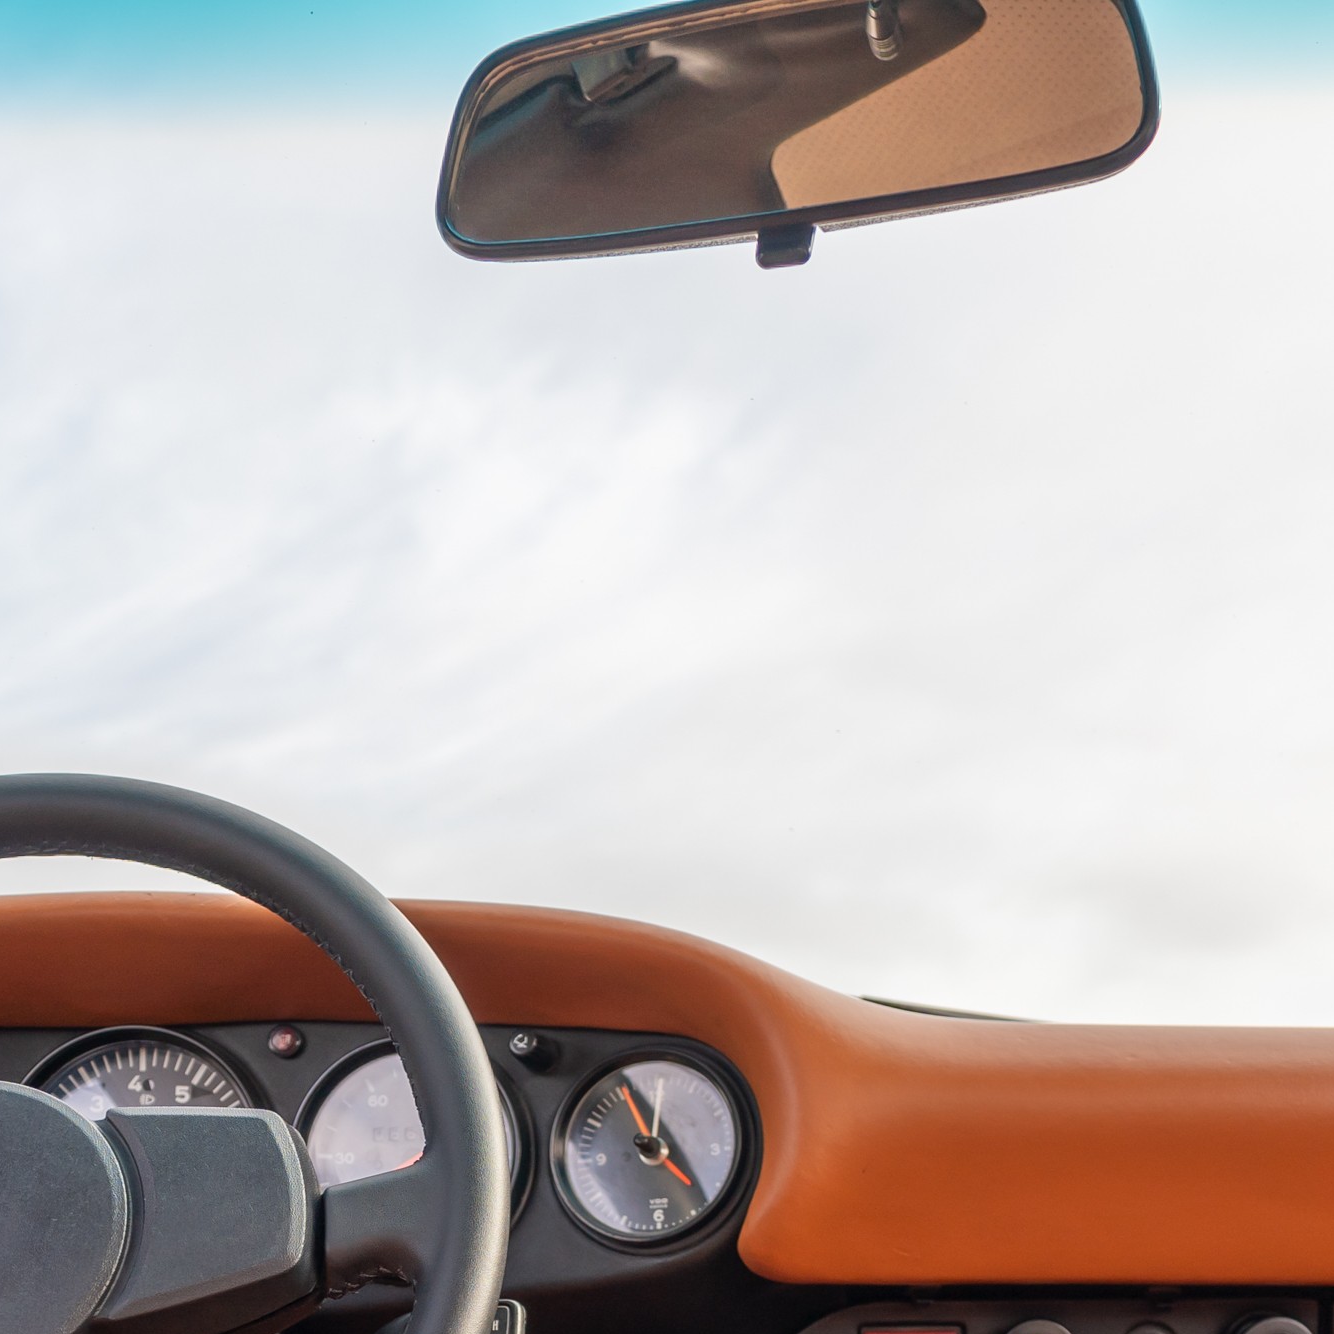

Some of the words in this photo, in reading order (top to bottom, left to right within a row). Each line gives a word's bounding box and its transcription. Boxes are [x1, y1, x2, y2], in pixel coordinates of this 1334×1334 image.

[127, 1074, 142, 1092] 4
[175, 1085, 191, 1104] 5
[367, 1094, 388, 1107] 60
[90, 1095, 104, 1113] 3
[710, 1142, 721, 1156] 3
[334, 1152, 356, 1165] 30
[595, 1153, 607, 1167] 9
[652, 1209, 665, 1222] 6
